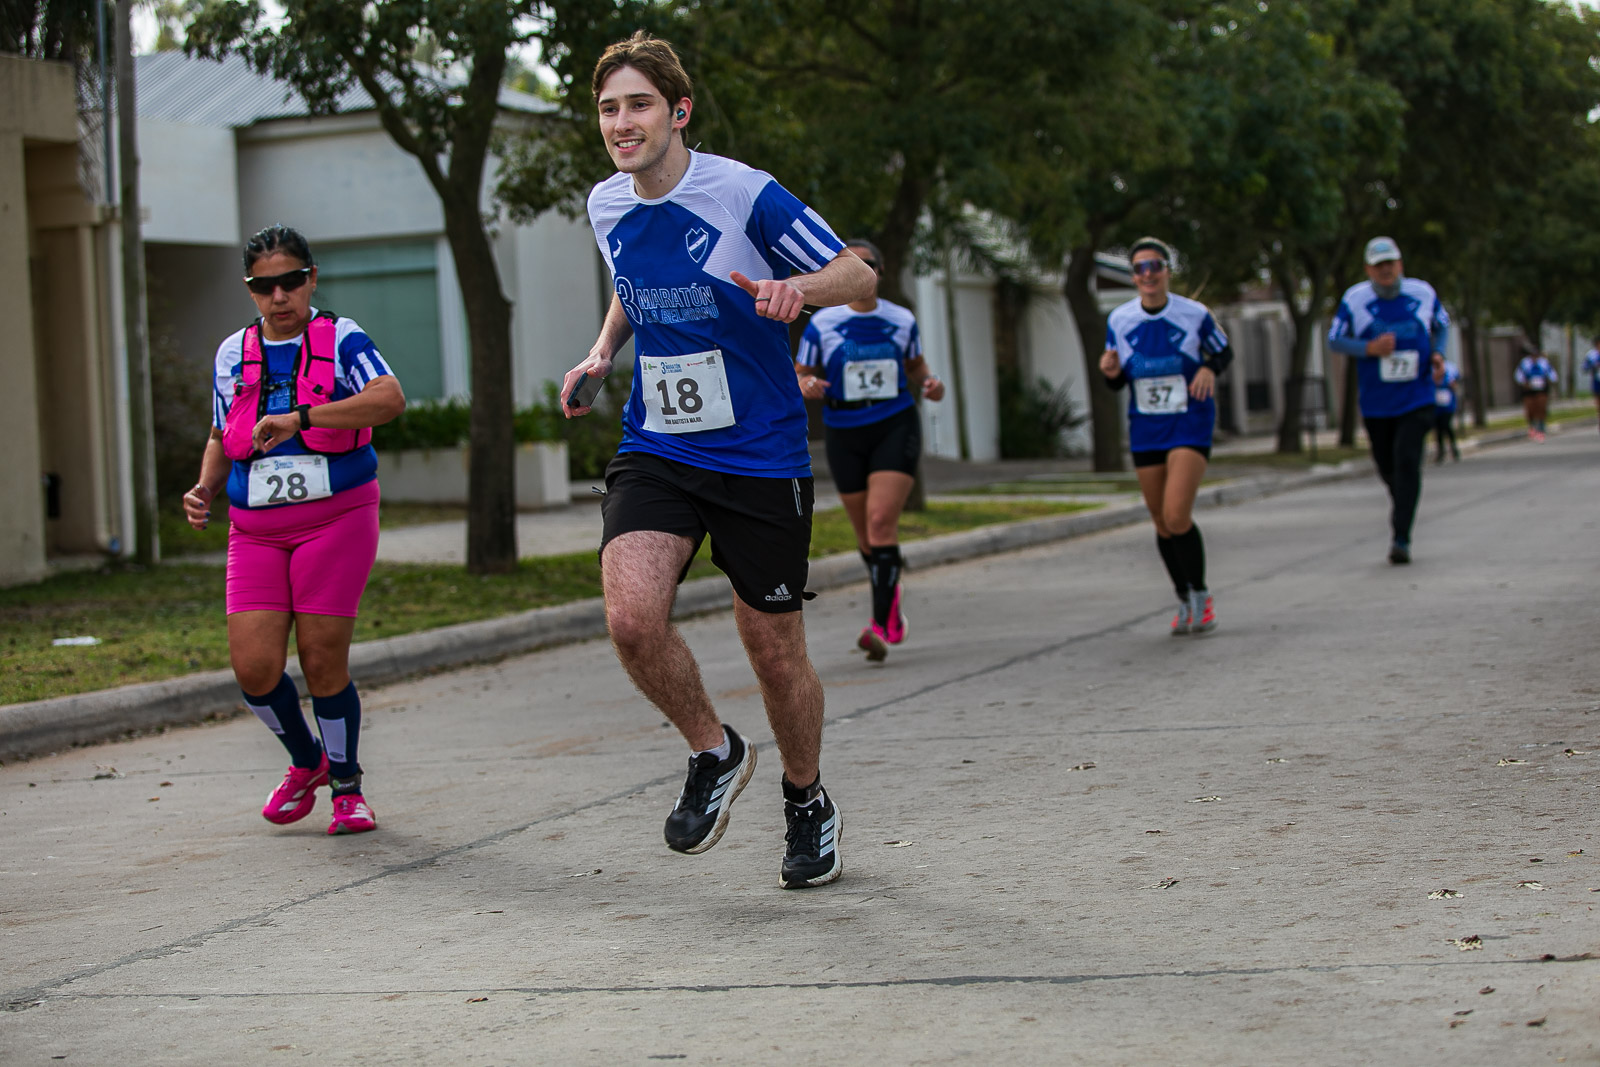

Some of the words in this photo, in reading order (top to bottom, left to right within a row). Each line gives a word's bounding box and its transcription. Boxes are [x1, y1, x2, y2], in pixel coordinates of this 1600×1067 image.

[615, 276, 643, 325] 3
[636, 283, 715, 310] MARATÓN
[858, 371, 886, 390] 14
[1148, 386, 1173, 404] 37
[656, 378, 703, 415] 18
[266, 473, 308, 503] 28
